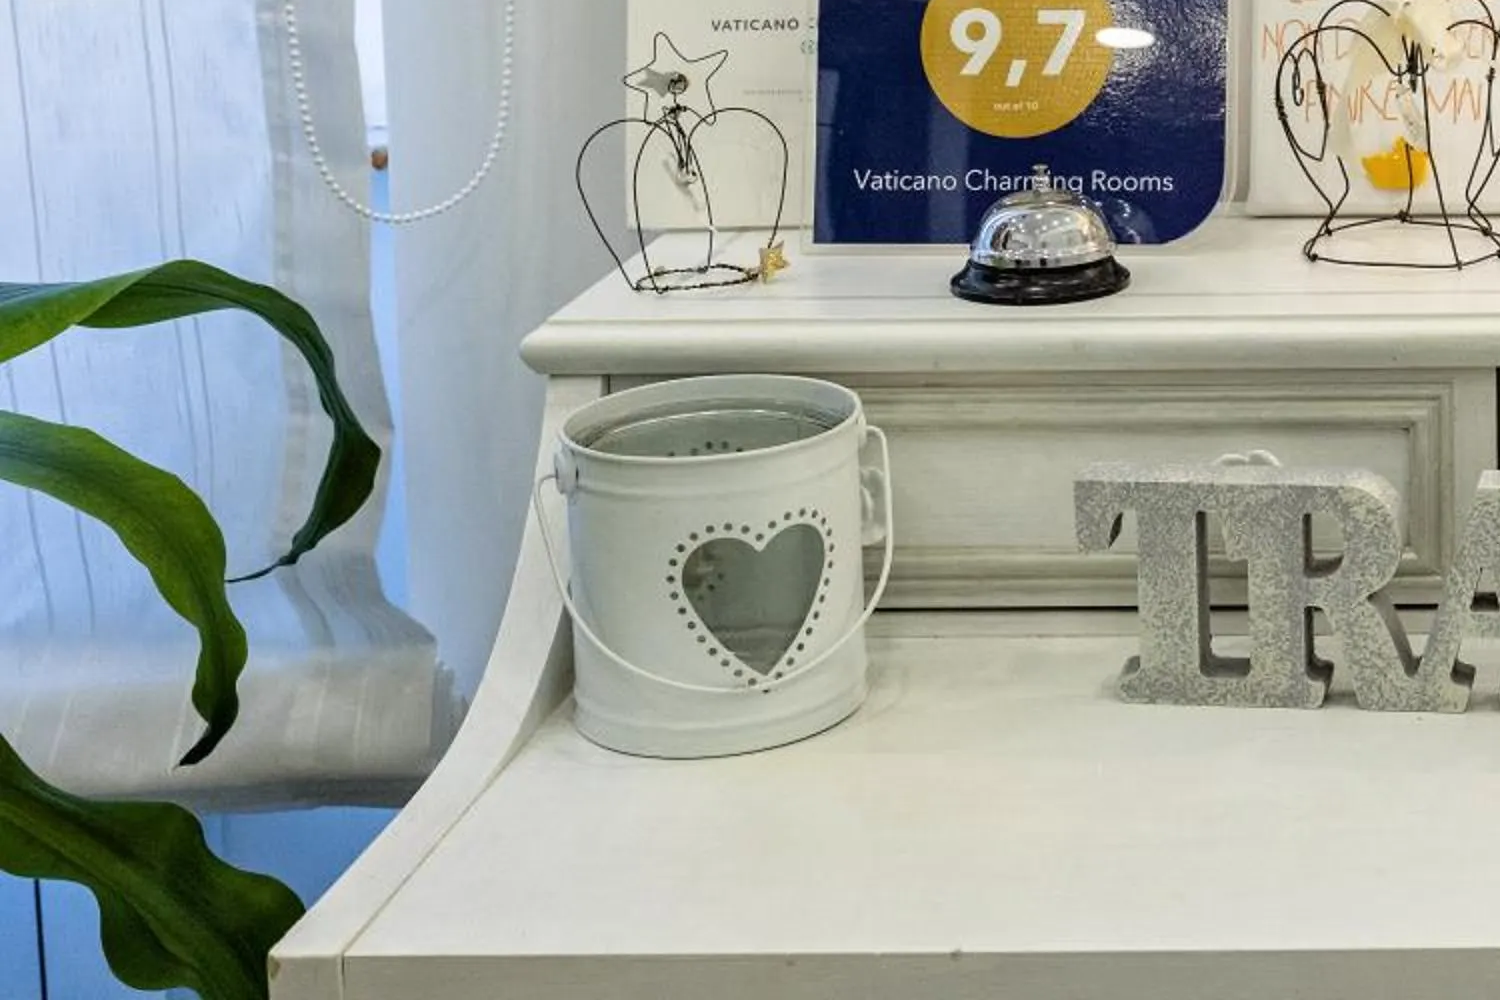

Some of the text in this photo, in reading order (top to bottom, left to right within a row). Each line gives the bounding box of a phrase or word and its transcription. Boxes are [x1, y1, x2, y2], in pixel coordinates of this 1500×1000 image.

[711, 18, 800, 32] VATICANO
[950, 7, 1087, 88] 9,7
[853, 168, 957, 191] Vaticano
[1091, 169, 1174, 192] Rooms
